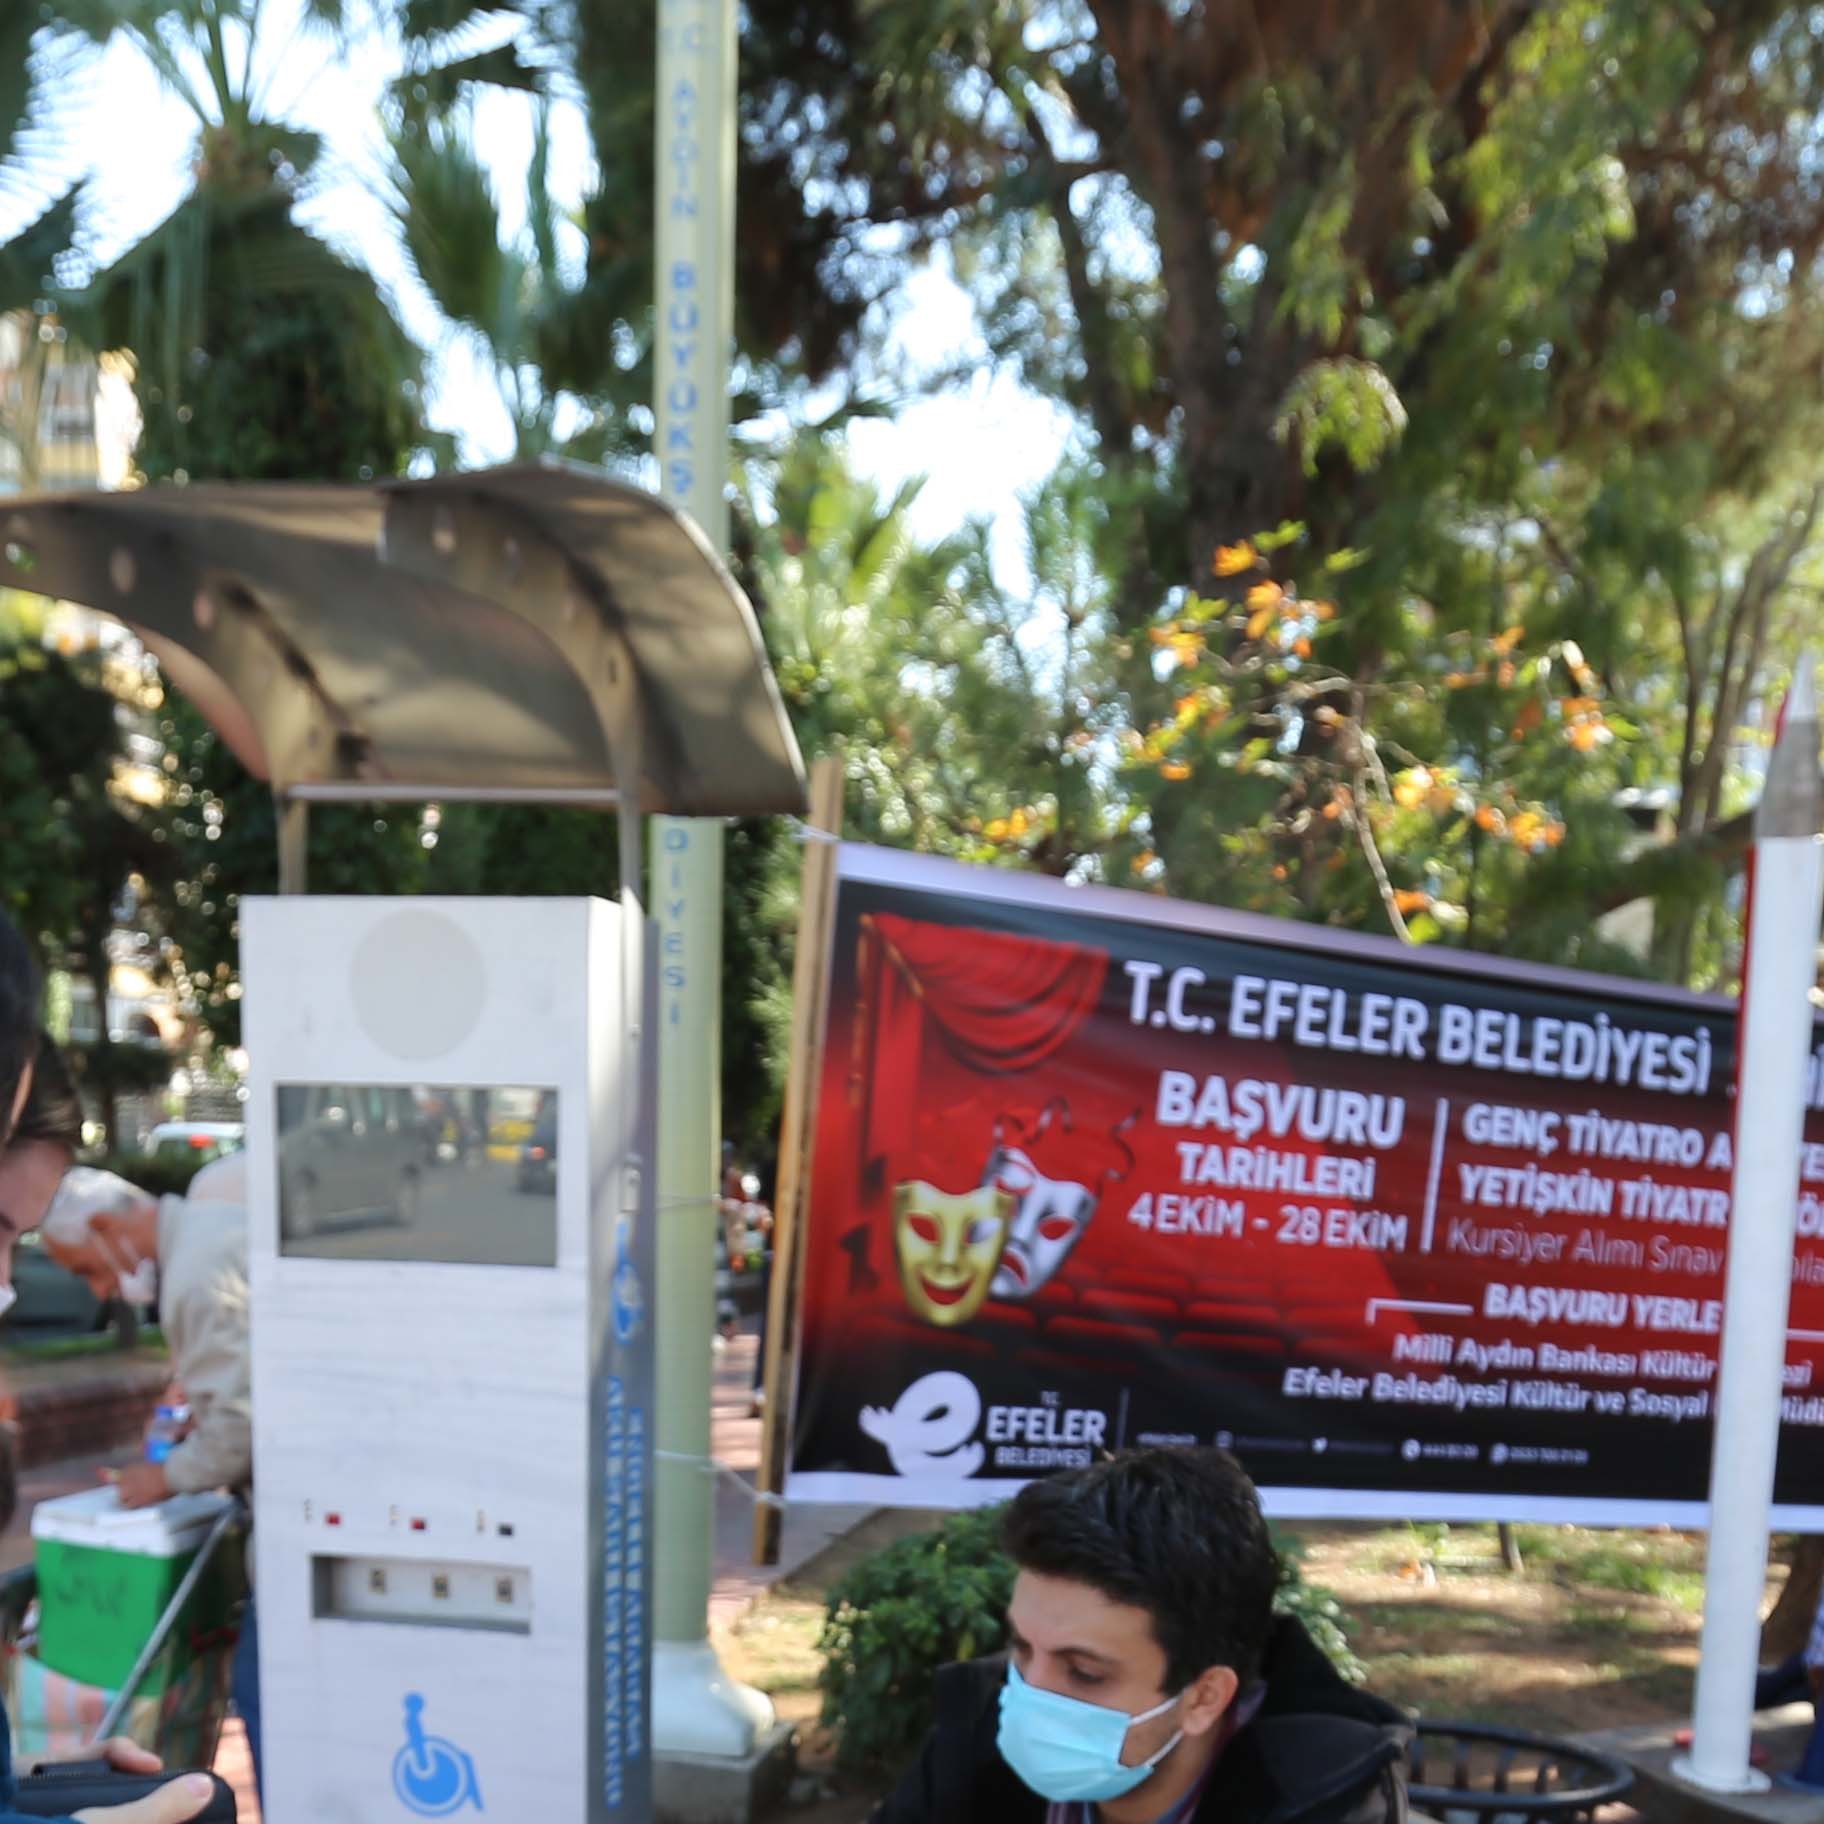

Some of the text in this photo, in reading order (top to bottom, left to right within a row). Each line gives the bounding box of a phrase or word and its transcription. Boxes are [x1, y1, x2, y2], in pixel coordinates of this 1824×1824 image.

[1124, 960, 1214, 1034] T.C.
[1228, 974, 1427, 1061] EFELER
[1437, 1003, 1711, 1095] BELEDİYESİ
[1156, 1068, 1405, 1150] BAŞVURU
[1461, 1102, 1559, 1157] GENÇ
[1567, 1107, 1703, 1167] TİYATRO
[1176, 1140, 1377, 1200] TARİHLERİ
[1459, 1161, 1613, 1216] YETİŞKİN
[1127, 1191, 1152, 1230] 4
[1152, 1193, 1244, 1238] EKİM
[1276, 1203, 1320, 1246] 28
[1320, 1206, 1408, 1252] EKİM
[1447, 1216, 1570, 1266] Kursiyer
[1571, 1227, 1644, 1269] Alımı
[1484, 1281, 1628, 1326] BAŞVURU
[1392, 1333, 1718, 1380] Milli Aydın Bankası Kültür
[1282, 1366, 1370, 1400] Efeler
[1370, 1371, 1508, 1412] Belediyesi
[1509, 1380, 1590, 1412] Kültür
[1592, 1389, 1626, 1415] ve
[1627, 1385, 1709, 1424] Sosyal
[986, 1405, 1107, 1446] EFELER
